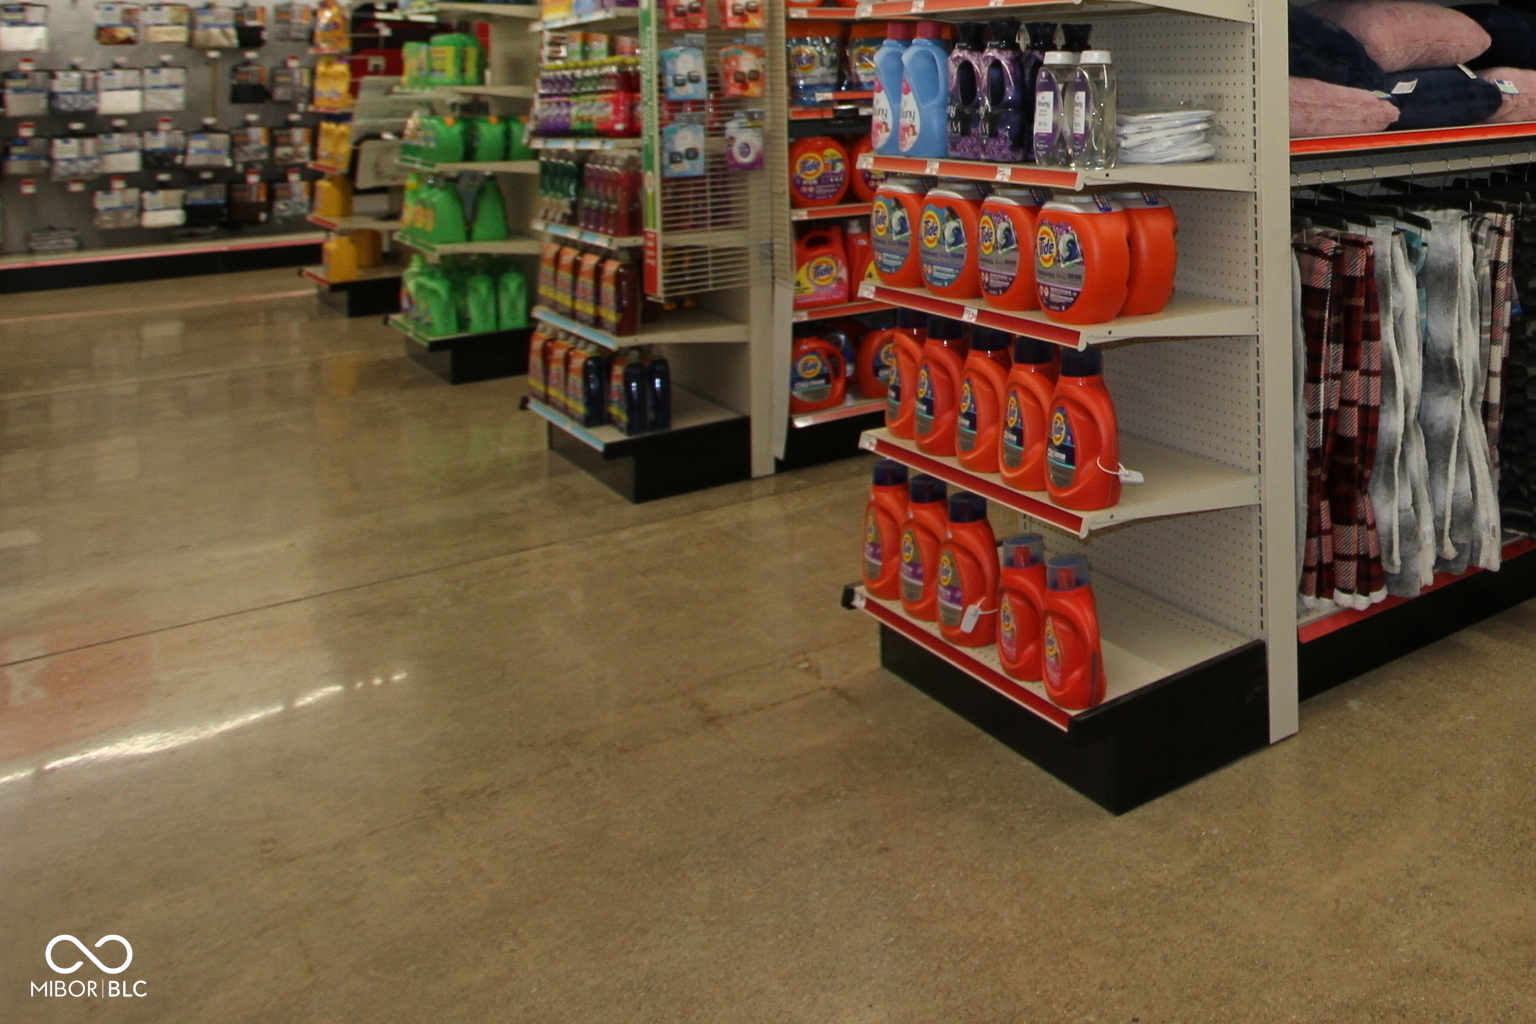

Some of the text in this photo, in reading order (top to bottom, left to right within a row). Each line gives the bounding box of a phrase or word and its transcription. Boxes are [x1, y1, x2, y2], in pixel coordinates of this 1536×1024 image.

[798, 158, 822, 174] Tide
[874, 210, 888, 226] Tide
[924, 219, 939, 237] Tide
[981, 225, 994, 242] Tide
[1039, 237, 1054, 255] Tide
